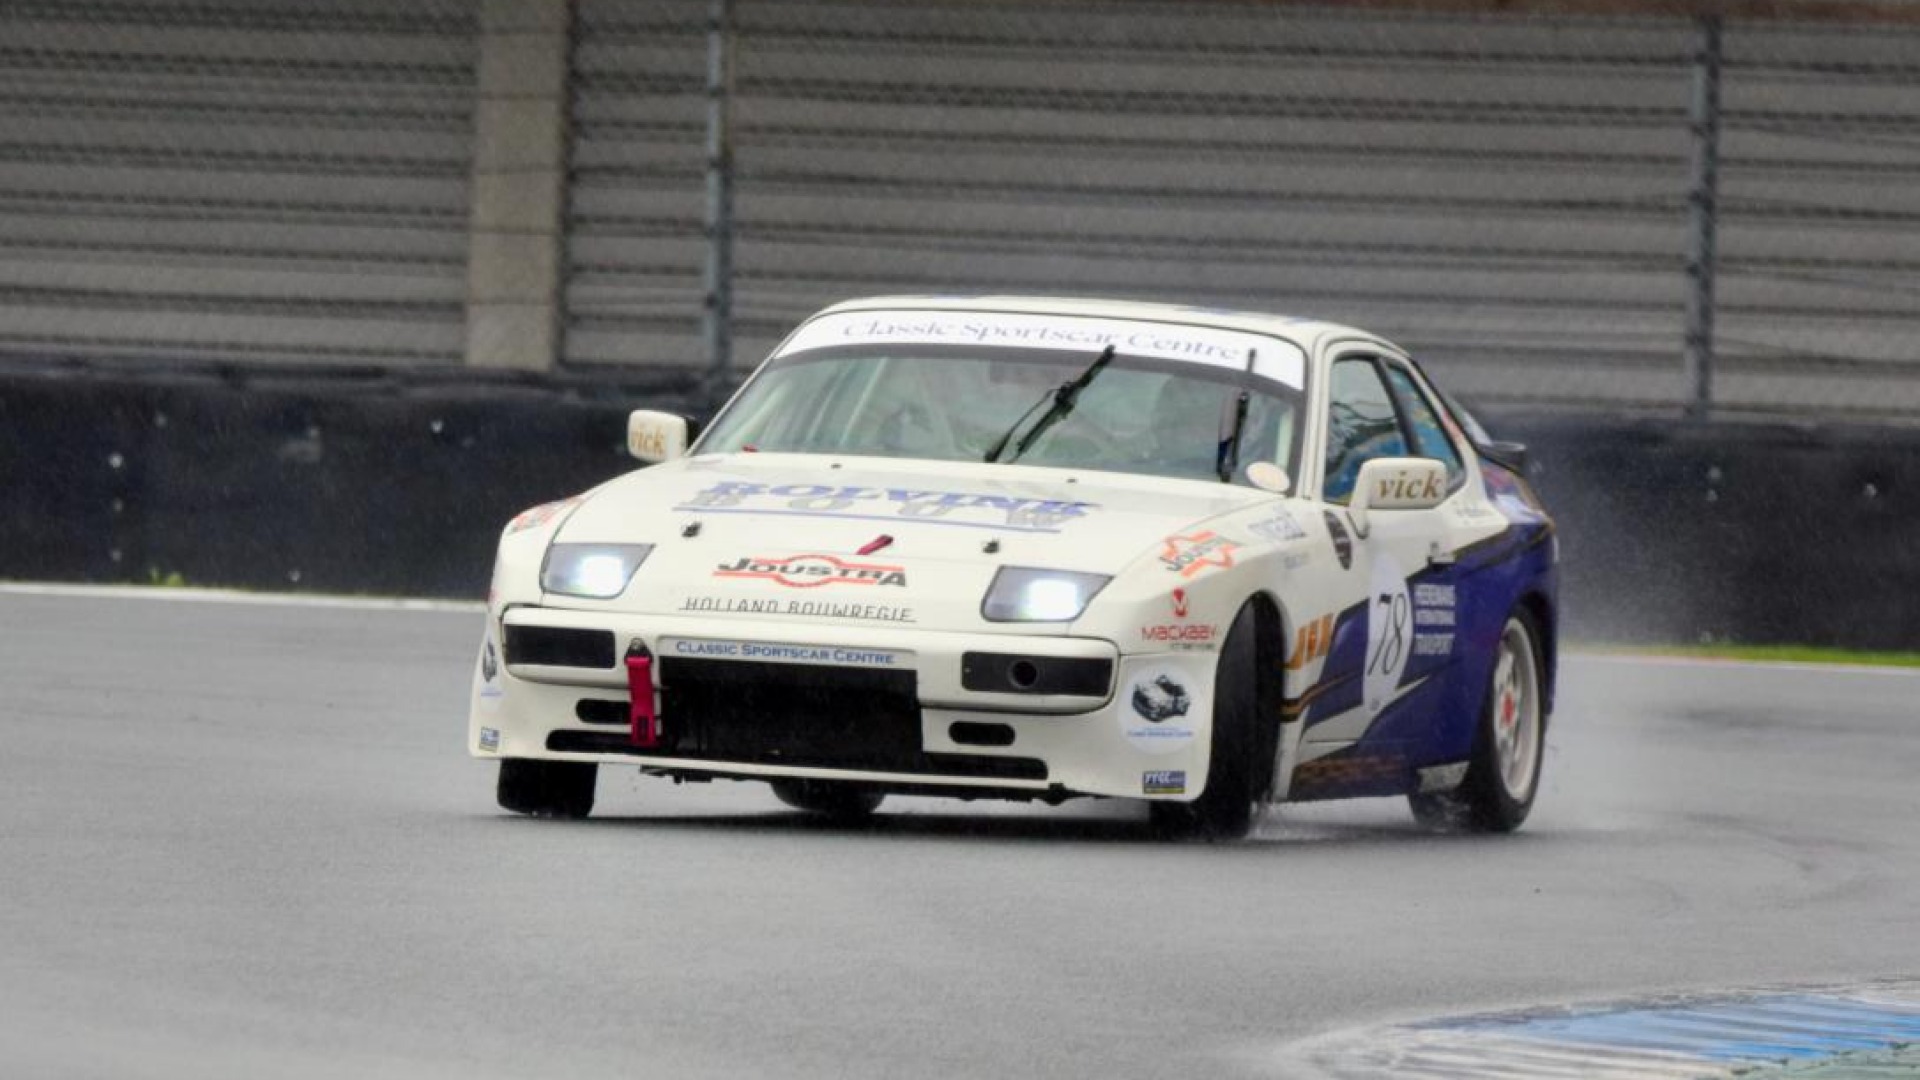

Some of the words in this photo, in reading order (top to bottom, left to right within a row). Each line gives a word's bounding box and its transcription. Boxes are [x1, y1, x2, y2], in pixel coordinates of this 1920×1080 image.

[843, 319, 949, 337] Classic
[960, 322, 1117, 345] Sportscar
[1127, 333, 1241, 360] Centre
[1377, 470, 1443, 500] vick
[716, 558, 906, 587] JOUSTRA
[685, 599, 779, 614] HOLLAND
[787, 602, 915, 621] BOUWREGIE
[1368, 592, 1407, 676] 78
[676, 640, 738, 655] CLASSIC
[742, 643, 830, 660] SPORTSCAR
[834, 648, 895, 664] CENTRE
